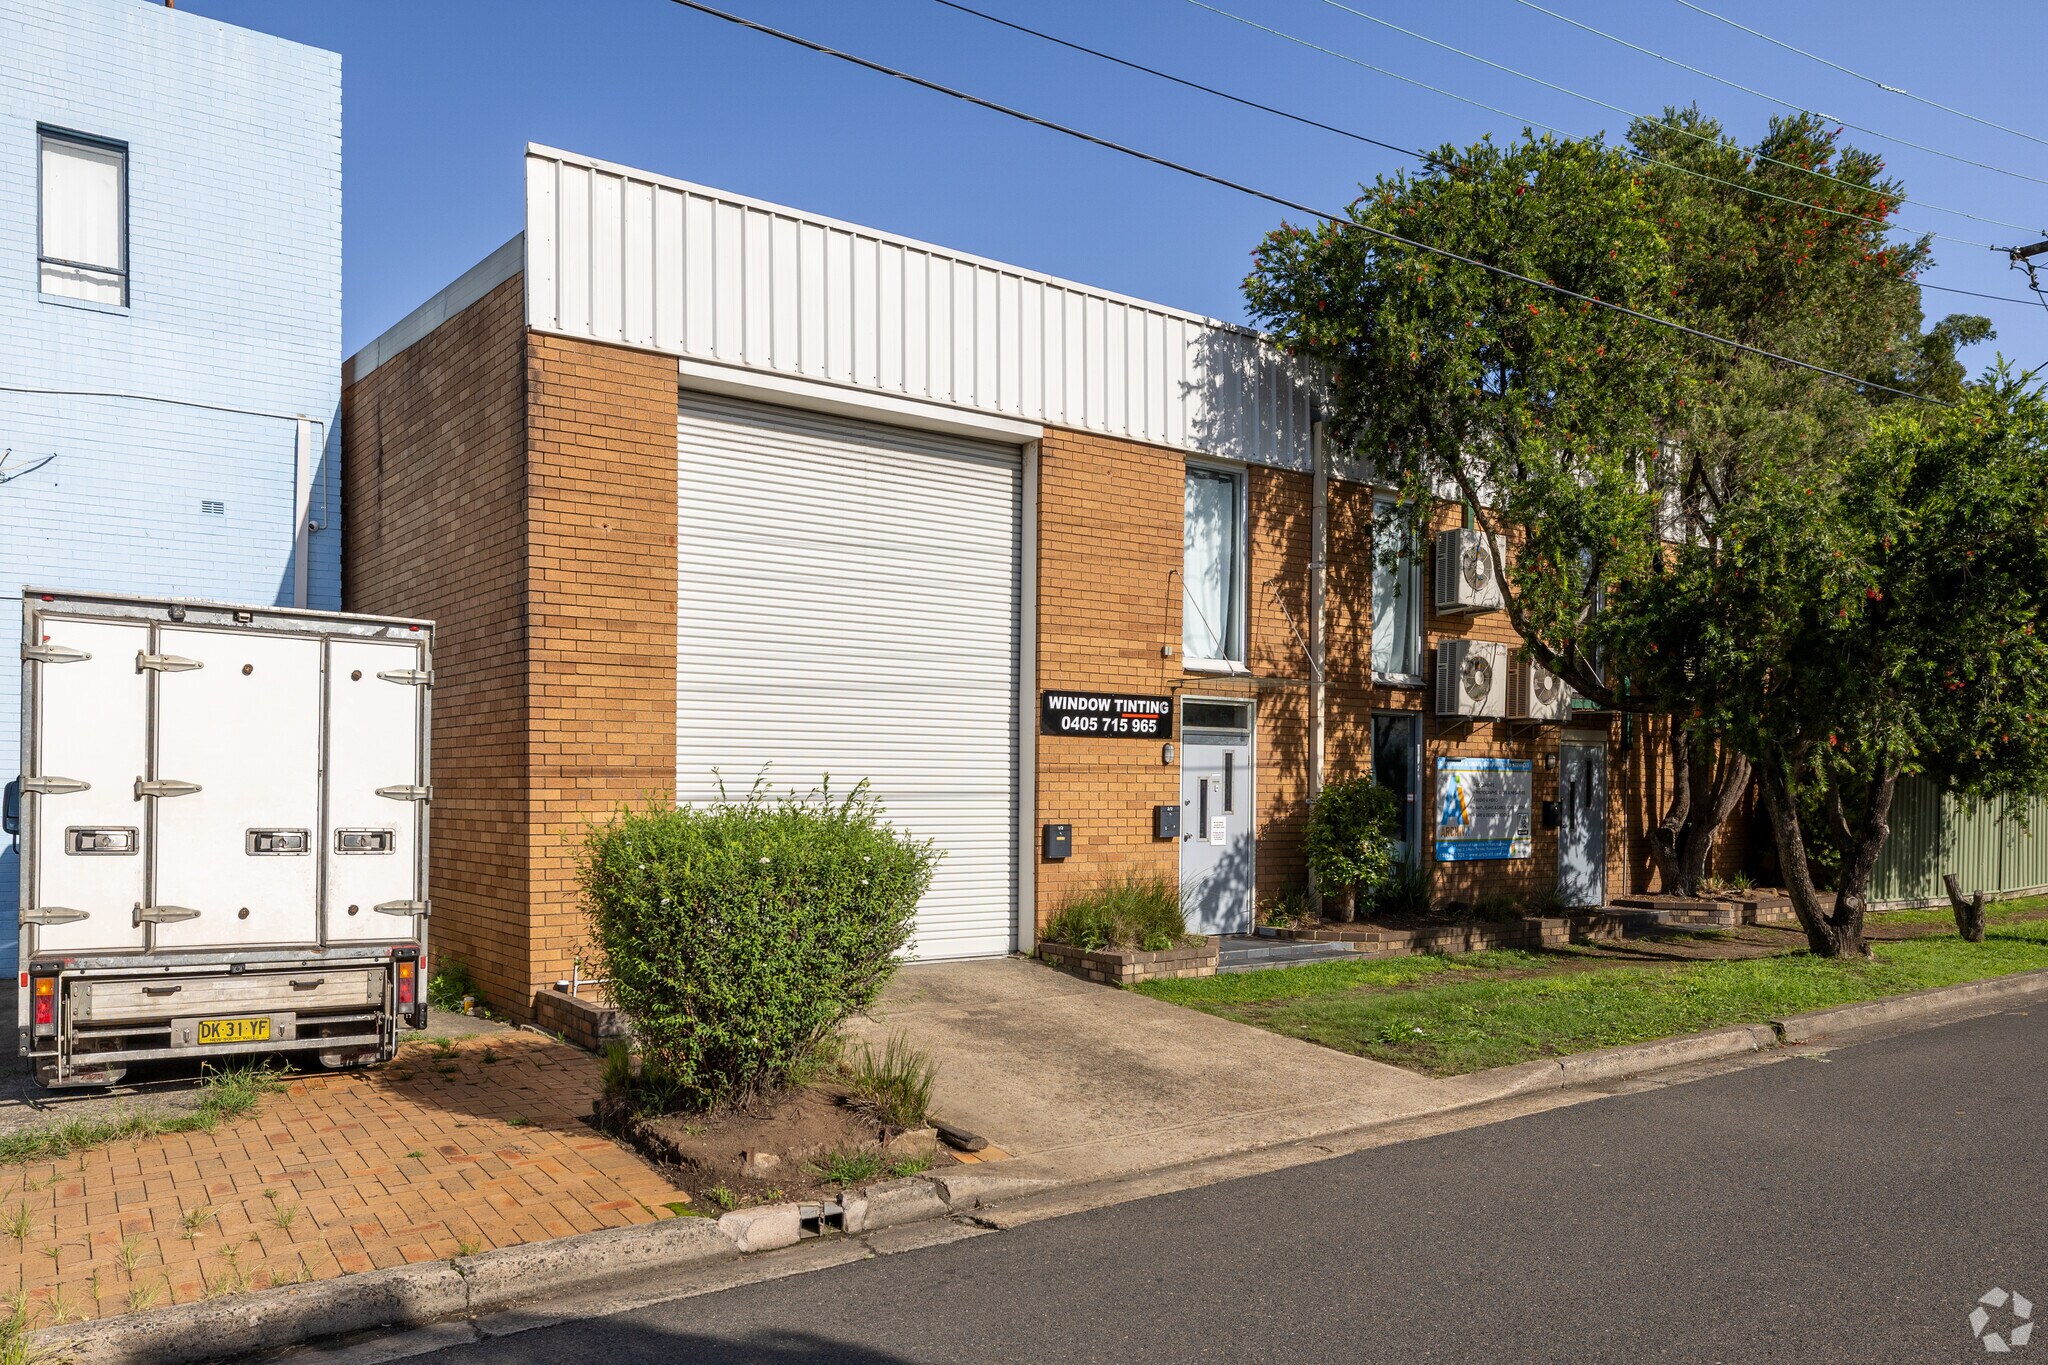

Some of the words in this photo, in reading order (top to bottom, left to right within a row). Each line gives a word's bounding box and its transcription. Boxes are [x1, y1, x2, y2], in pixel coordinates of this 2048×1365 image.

[1048, 695, 1111, 712] WINDOW
[1114, 699, 1170, 715] TINTING
[1061, 715, 1098, 731] 0405
[1102, 717, 1128, 732] 715
[1131, 718, 1157, 733] 965
